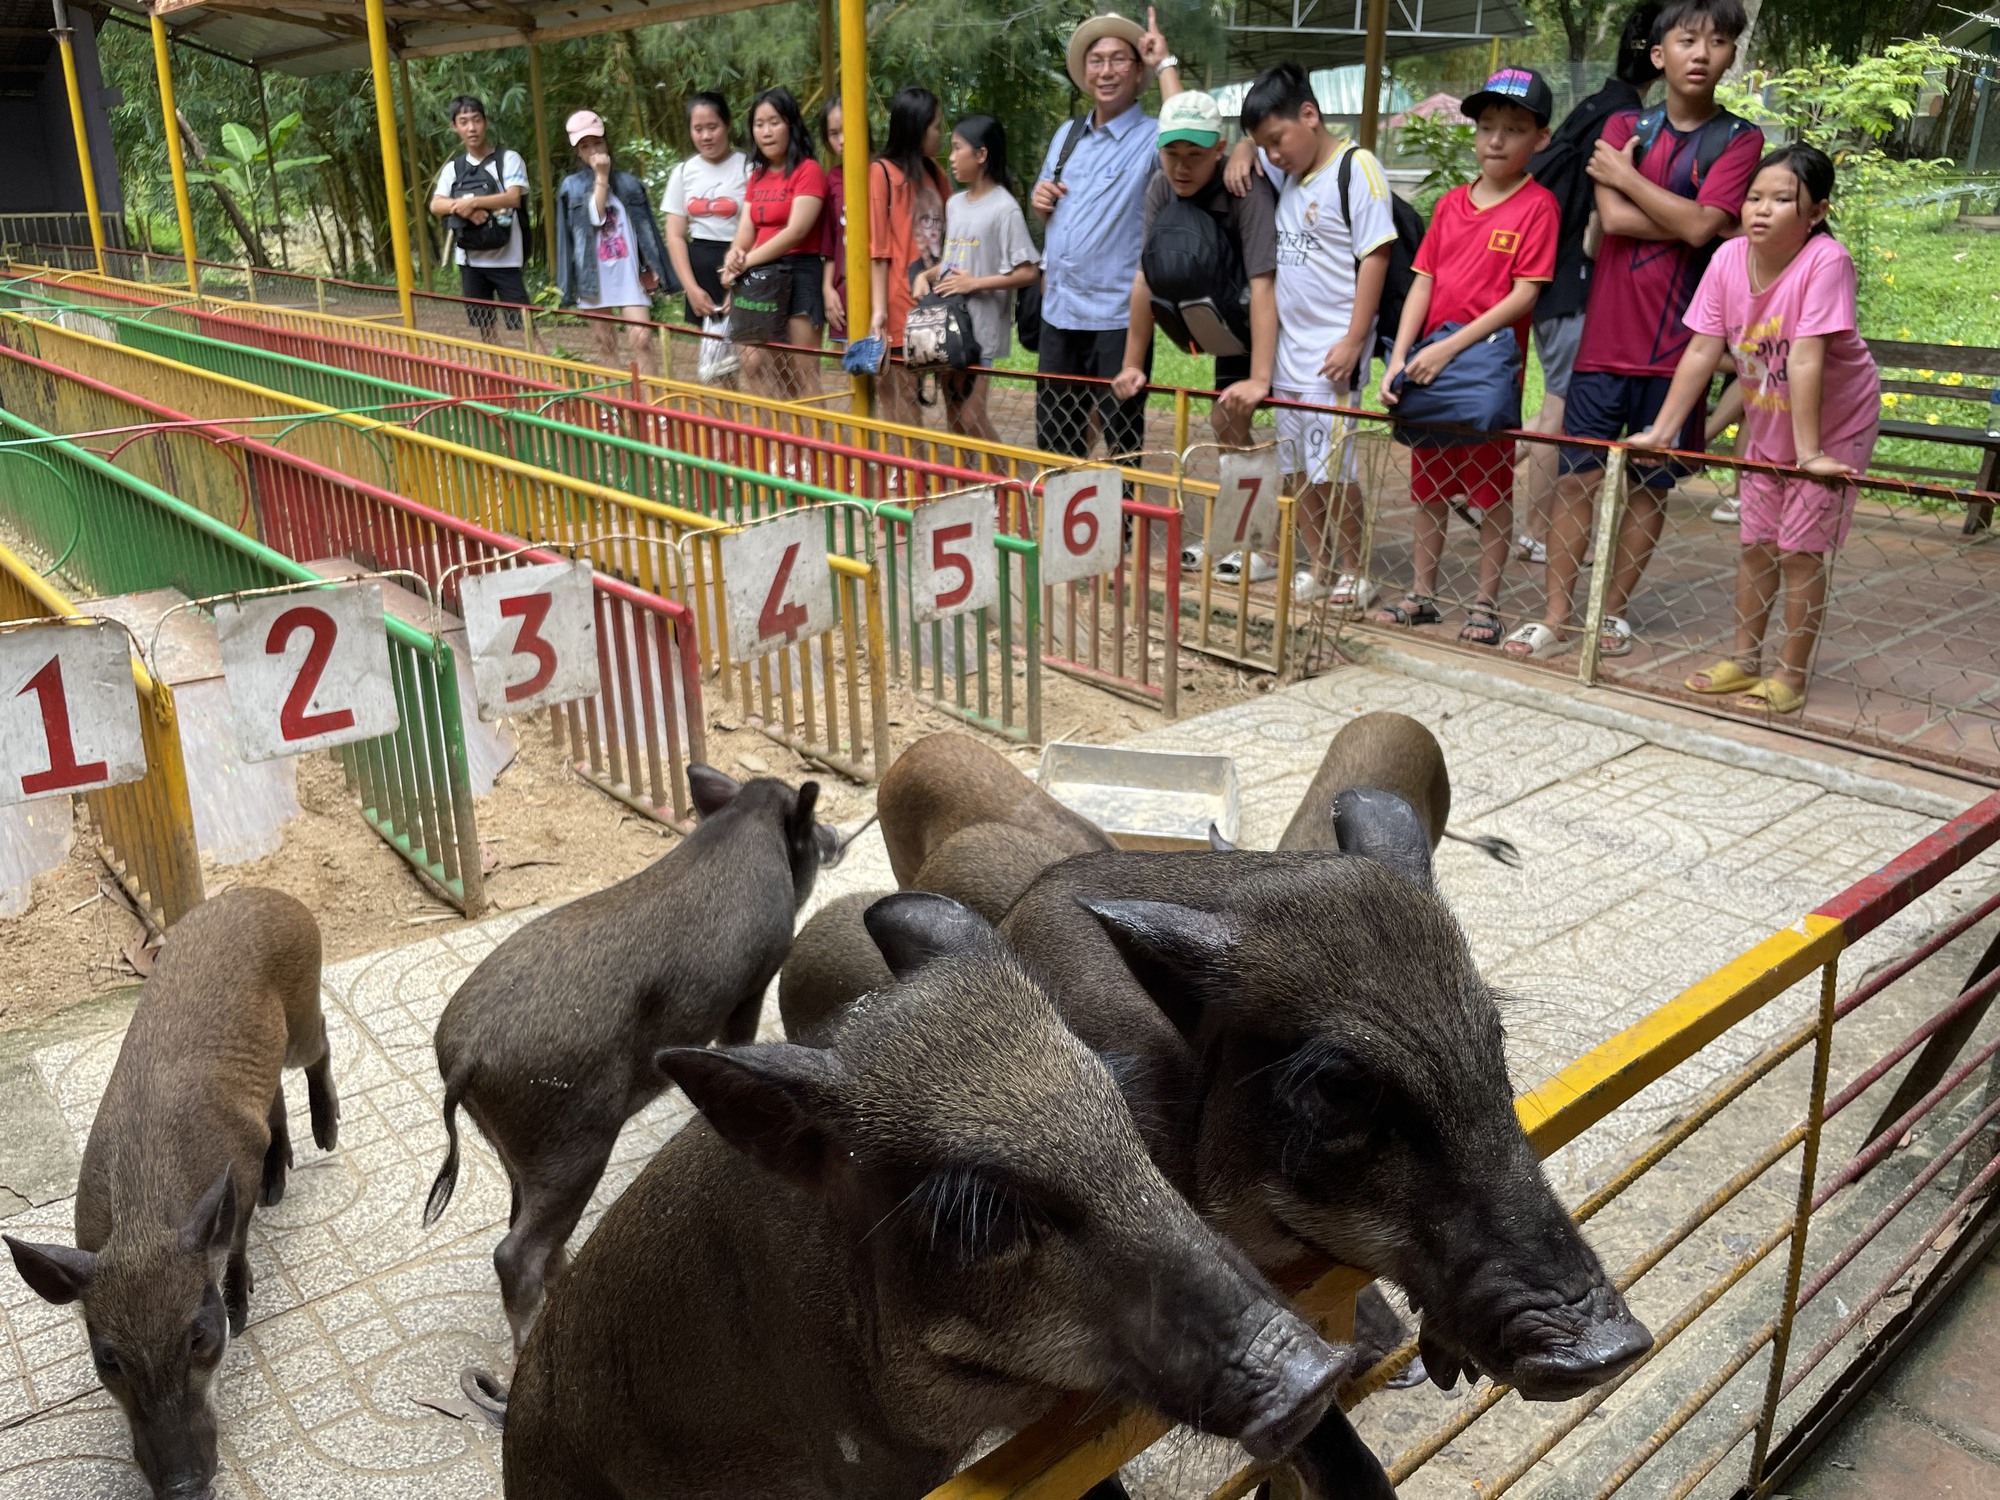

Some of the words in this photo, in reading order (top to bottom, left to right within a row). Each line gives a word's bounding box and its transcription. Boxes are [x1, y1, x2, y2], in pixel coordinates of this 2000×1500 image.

[1309, 428, 1324, 459] 9
[1063, 485, 1099, 555] 6
[1235, 478, 1262, 542] 7
[758, 543, 808, 643] 4
[933, 523, 974, 608] 5
[265, 606, 355, 741] 2
[499, 592, 557, 702] 3
[18, 655, 108, 795] 1
